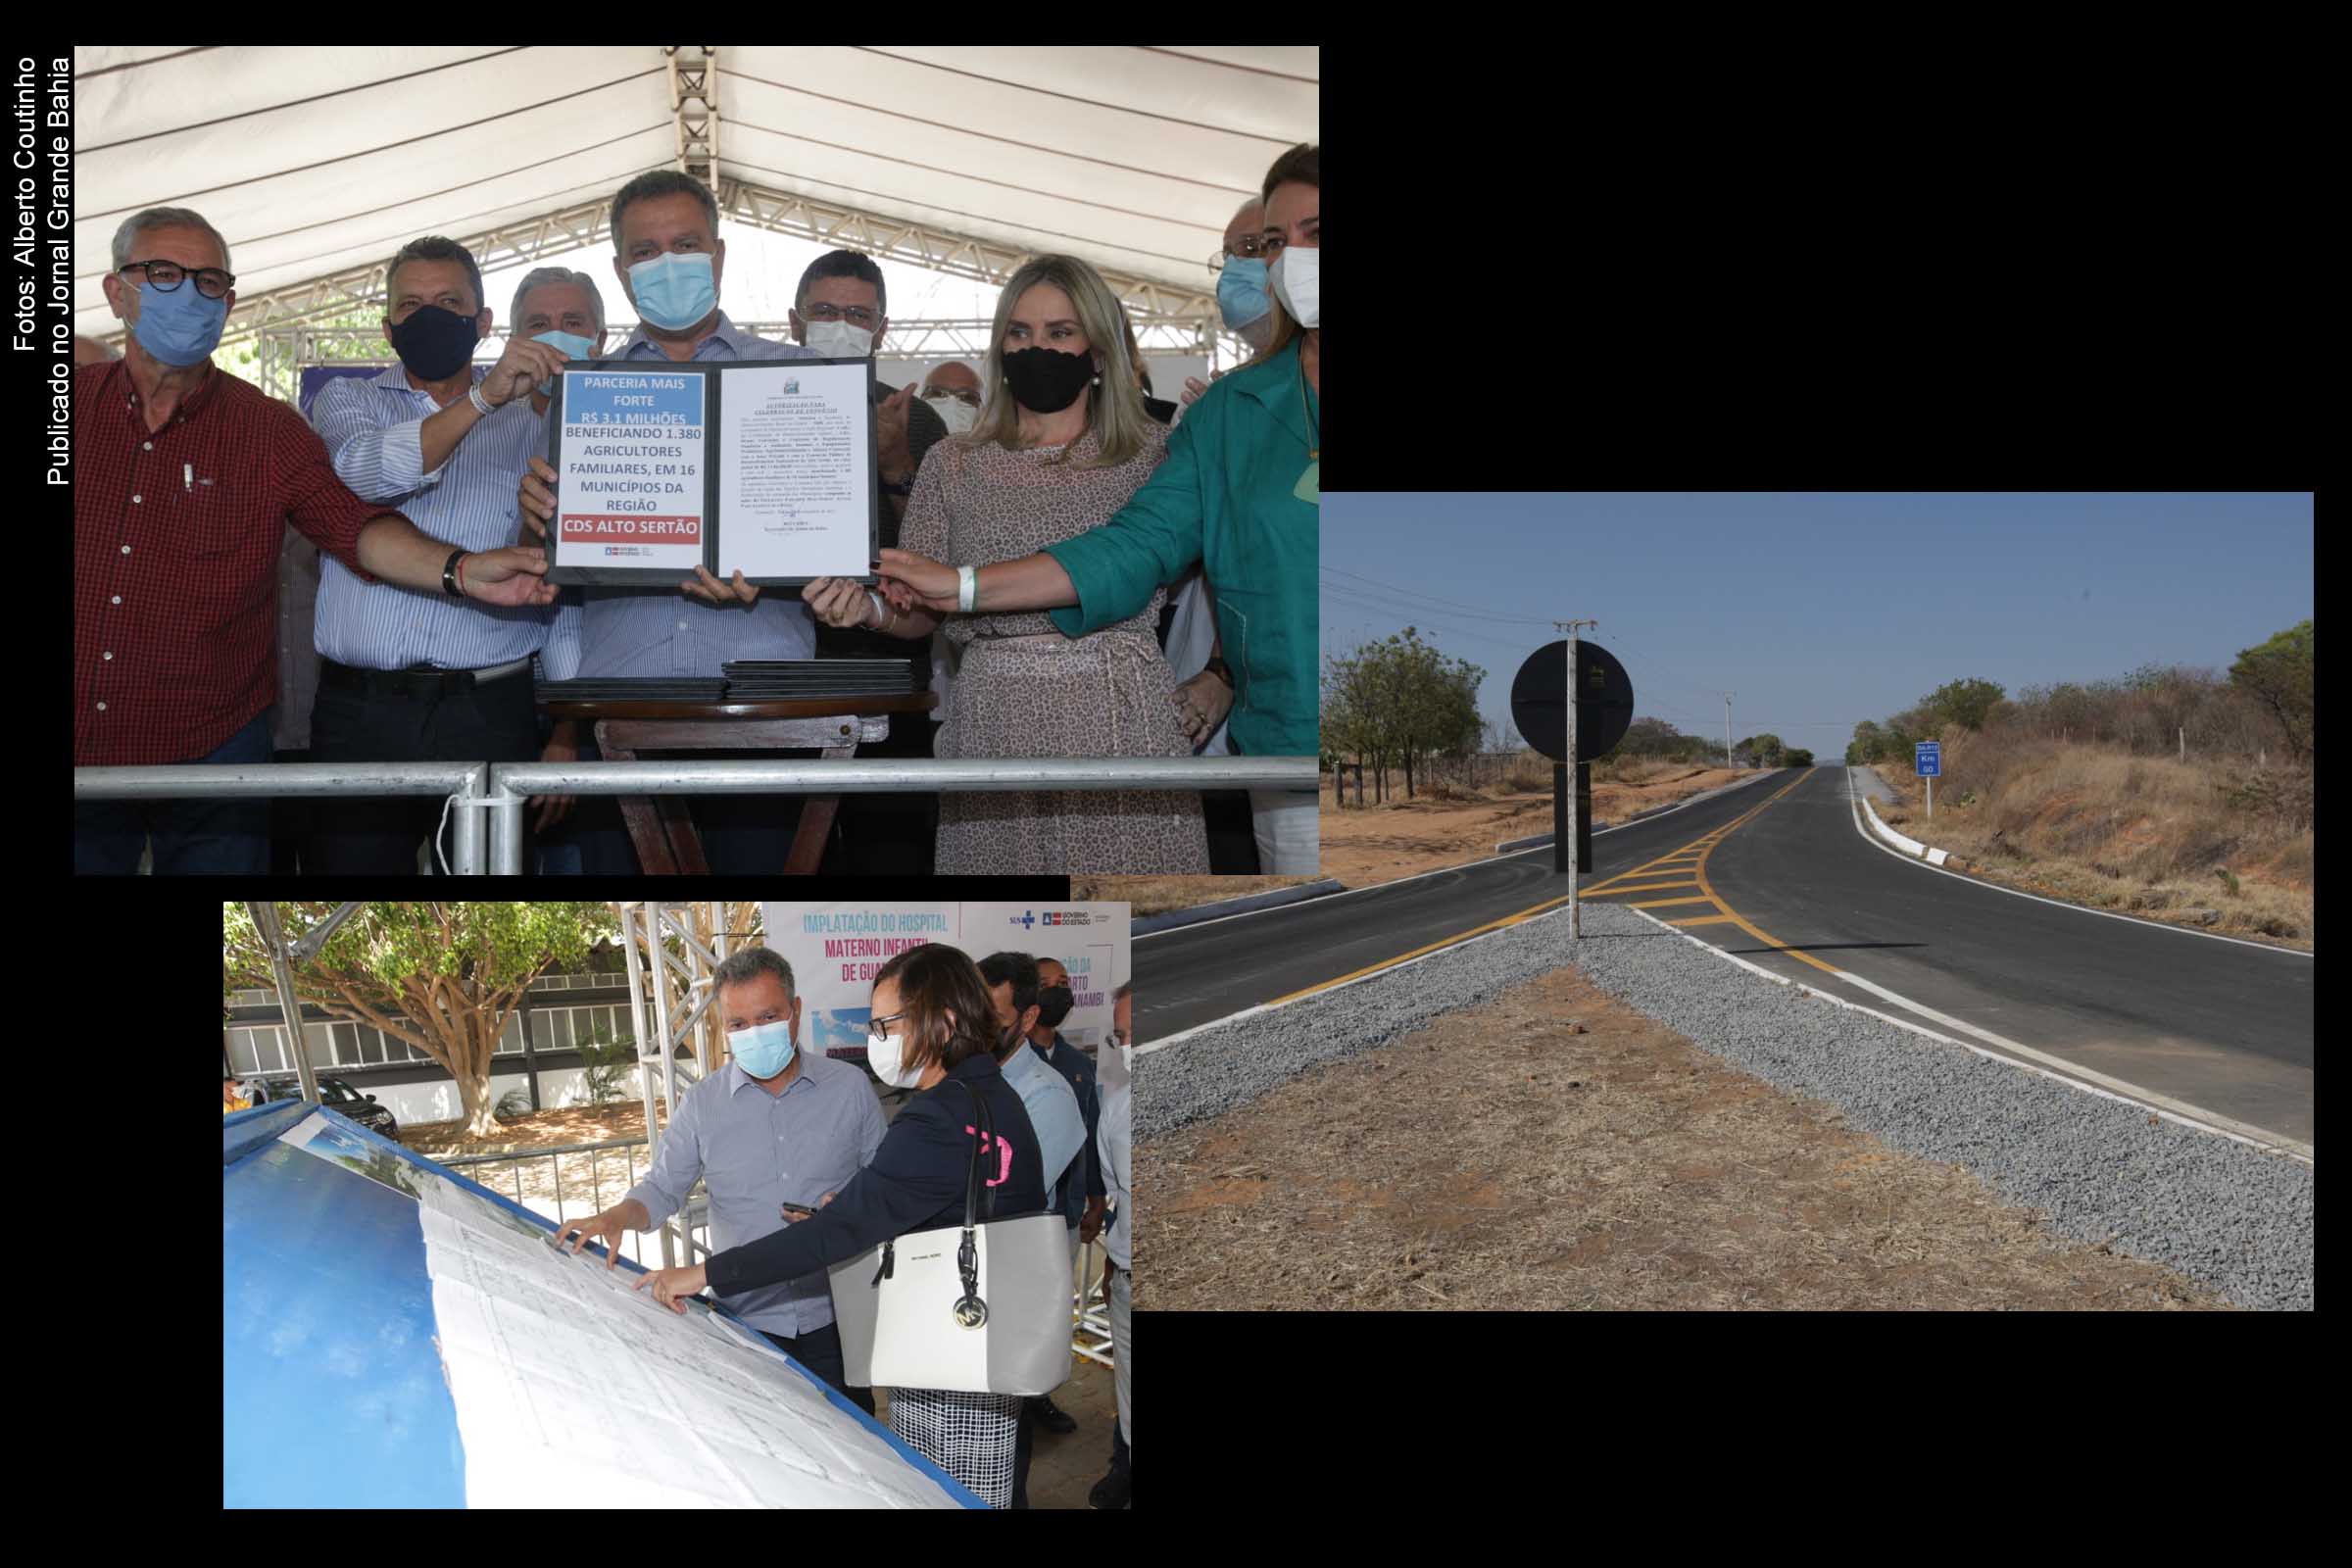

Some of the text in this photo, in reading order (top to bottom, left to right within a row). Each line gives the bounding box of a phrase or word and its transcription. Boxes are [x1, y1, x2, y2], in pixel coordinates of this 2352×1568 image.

[584, 376, 685, 390] PARCERIA MAIS
[613, 395, 656, 407] FORTE
[581, 412, 598, 424] R$
[626, 411, 686, 425] MILHÕES
[565, 426, 702, 440] BENEFICIANDO 1.380
[584, 445, 683, 457] AGRICULTORES
[569, 463, 696, 476] FAMILIARES, EM 16
[580, 479, 684, 494] MUNICÍPIOS DA
[607, 497, 658, 512] REGIÃO
[564, 518, 698, 534] CDS ALTO SERTÃO
[803, 910, 949, 935] IMPLATAÇÃO DO HOSPITAL
[825, 937, 928, 957] MATERNO INFAN
[842, 962, 885, 981] DE GUA
